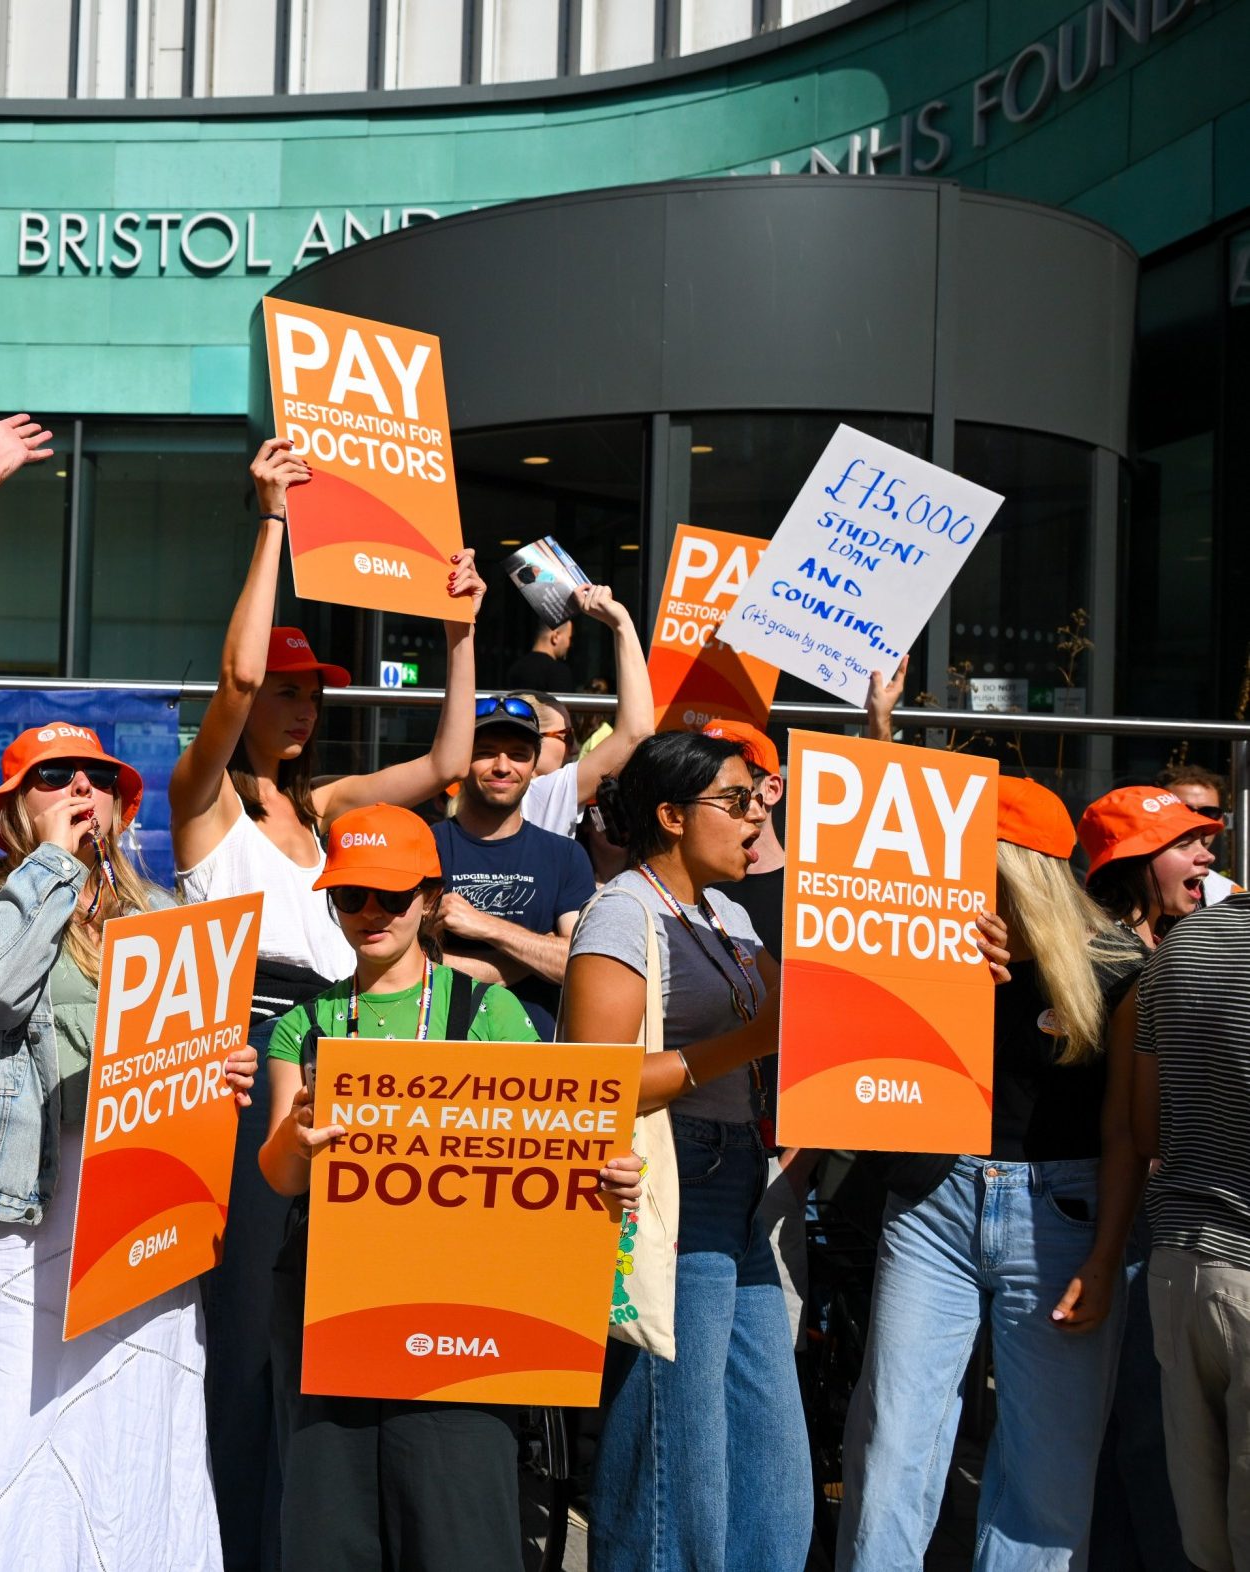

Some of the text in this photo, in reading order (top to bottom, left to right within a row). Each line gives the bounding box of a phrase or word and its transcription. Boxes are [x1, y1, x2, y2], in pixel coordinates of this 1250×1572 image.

[973, 0, 1196, 147] FOUN
[17, 211, 271, 269] BRISTOL
[293, 208, 440, 266] AN
[275, 312, 431, 420] PAY
[284, 399, 442, 447] RESTORATION FOR
[286, 422, 446, 483] DOCTORS
[817, 511, 930, 565] STUDENT
[828, 537, 881, 572] LOAN
[374, 556, 411, 579] BMA
[670, 536, 766, 604] PA
[798, 557, 862, 597] AND
[667, 600, 730, 622] RESTORA
[765, 620, 800, 641] grown
[801, 632, 815, 653] by
[816, 643, 841, 661] more
[798, 749, 988, 881] PAY
[354, 833, 387, 847] BMA
[797, 870, 985, 914] RESTORATION FOR
[796, 903, 985, 966] DOCTORS
[103, 911, 255, 1056] PAY
[100, 1024, 242, 1089] RESTORATION FOR
[334, 1073, 621, 1104] £18.62/HOUR IS
[878, 1079, 922, 1104] BMA
[331, 1103, 618, 1133] NOT A FAIR WAGE
[330, 1132, 614, 1161] FOR A RESIDENT
[327, 1161, 606, 1212] DOCTOR
[145, 1225, 178, 1260] BMA
[437, 1336, 500, 1358] BMA
